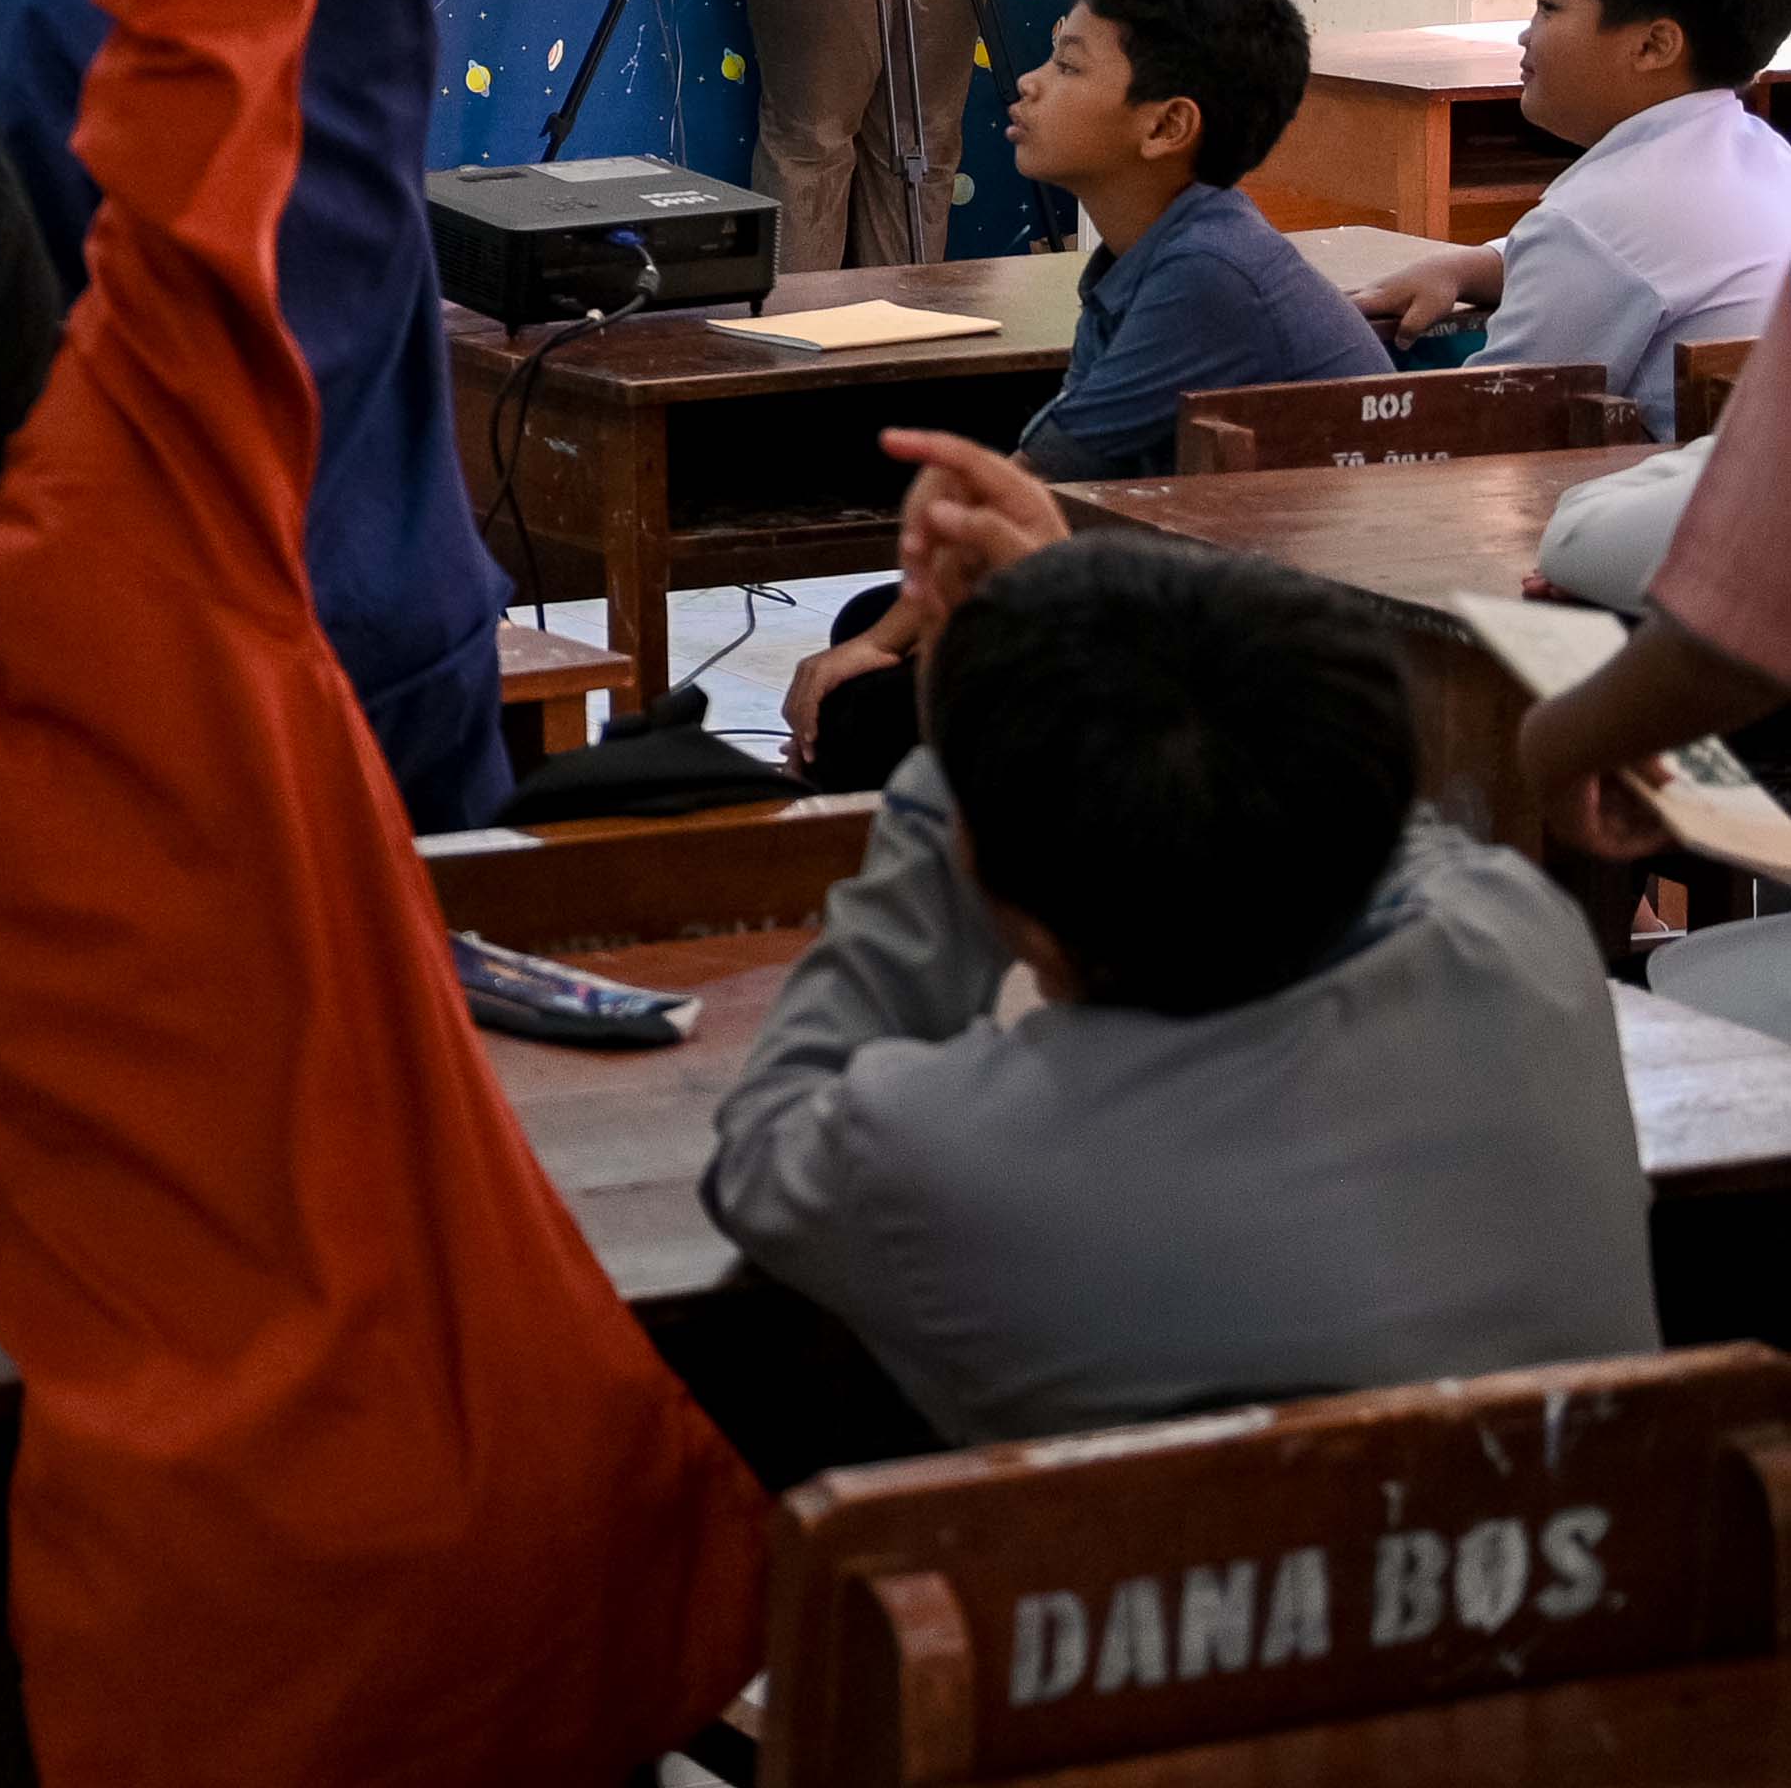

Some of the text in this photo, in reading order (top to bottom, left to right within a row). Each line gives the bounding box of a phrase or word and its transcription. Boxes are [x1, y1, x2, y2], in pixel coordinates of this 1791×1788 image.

[1360, 391, 1414, 422] BOS
[1008, 1504, 1613, 1709] DANA BOS
